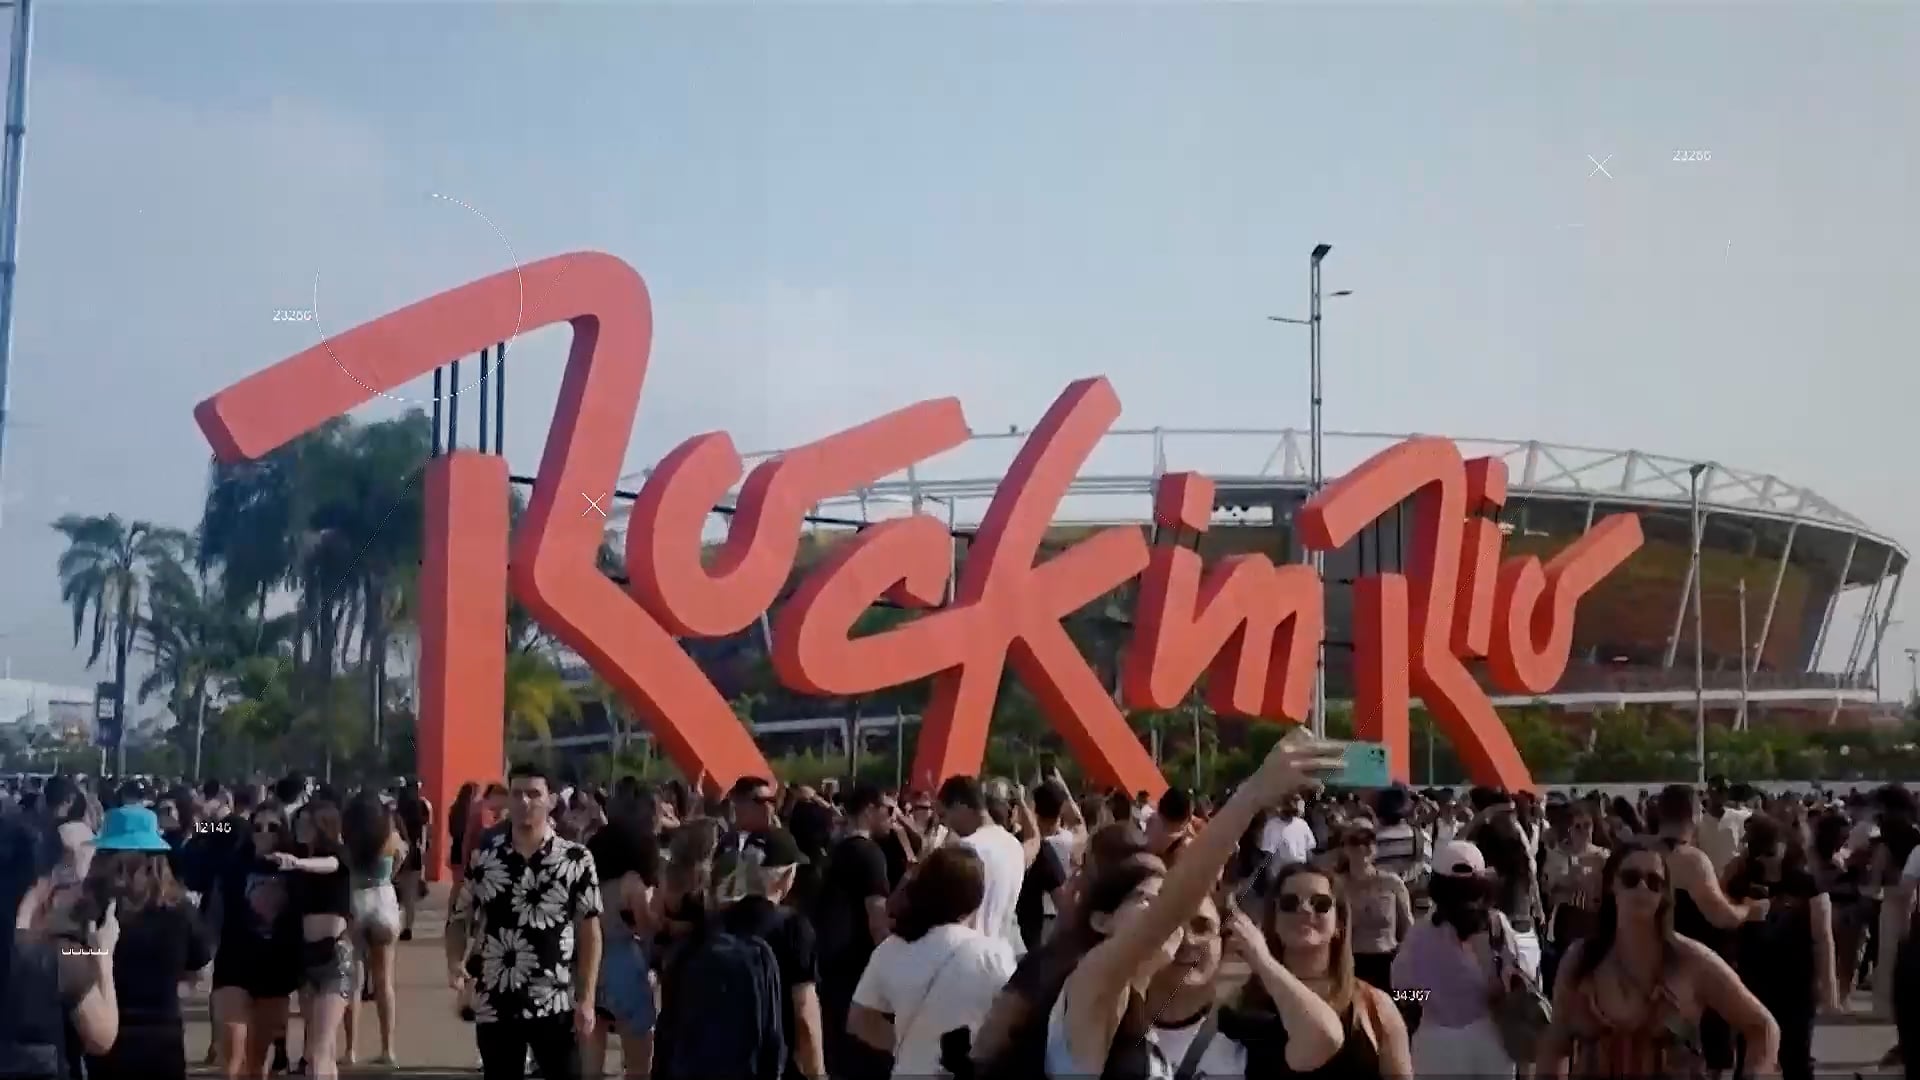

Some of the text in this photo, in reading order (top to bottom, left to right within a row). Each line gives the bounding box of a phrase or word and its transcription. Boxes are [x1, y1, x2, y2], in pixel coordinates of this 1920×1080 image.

[194, 250, 1644, 881] Rock in Rio
